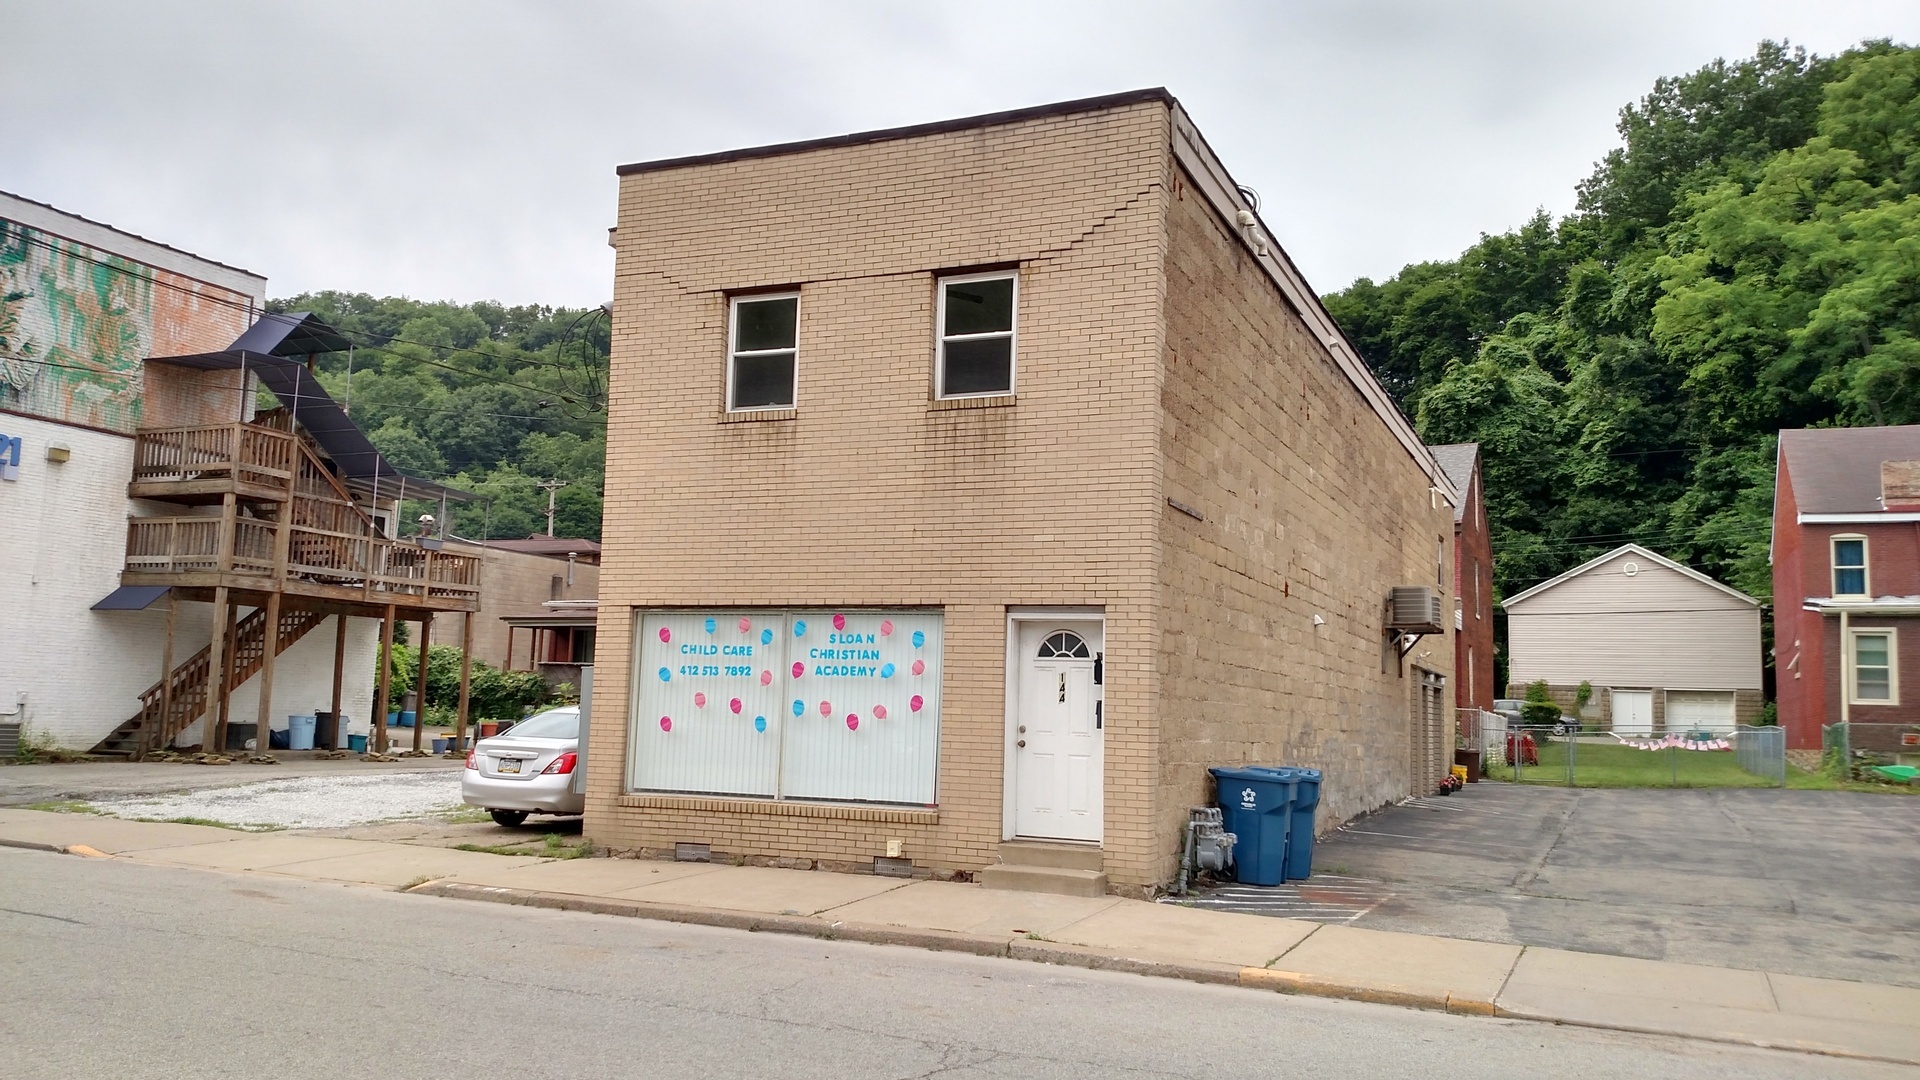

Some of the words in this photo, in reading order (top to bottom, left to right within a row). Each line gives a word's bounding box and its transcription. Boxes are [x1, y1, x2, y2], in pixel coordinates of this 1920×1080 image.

[829, 633, 875, 645] SLOAN
[680, 644, 719, 656] CHILD
[722, 645, 753, 657] CARE
[809, 648, 880, 661] CHRISTIAN
[679, 665, 699, 676] 412
[701, 665, 719, 677] 513
[724, 665, 752, 677] 7892
[814, 665, 877, 677] ACADEMY
[1058, 672, 1066, 703] 144
